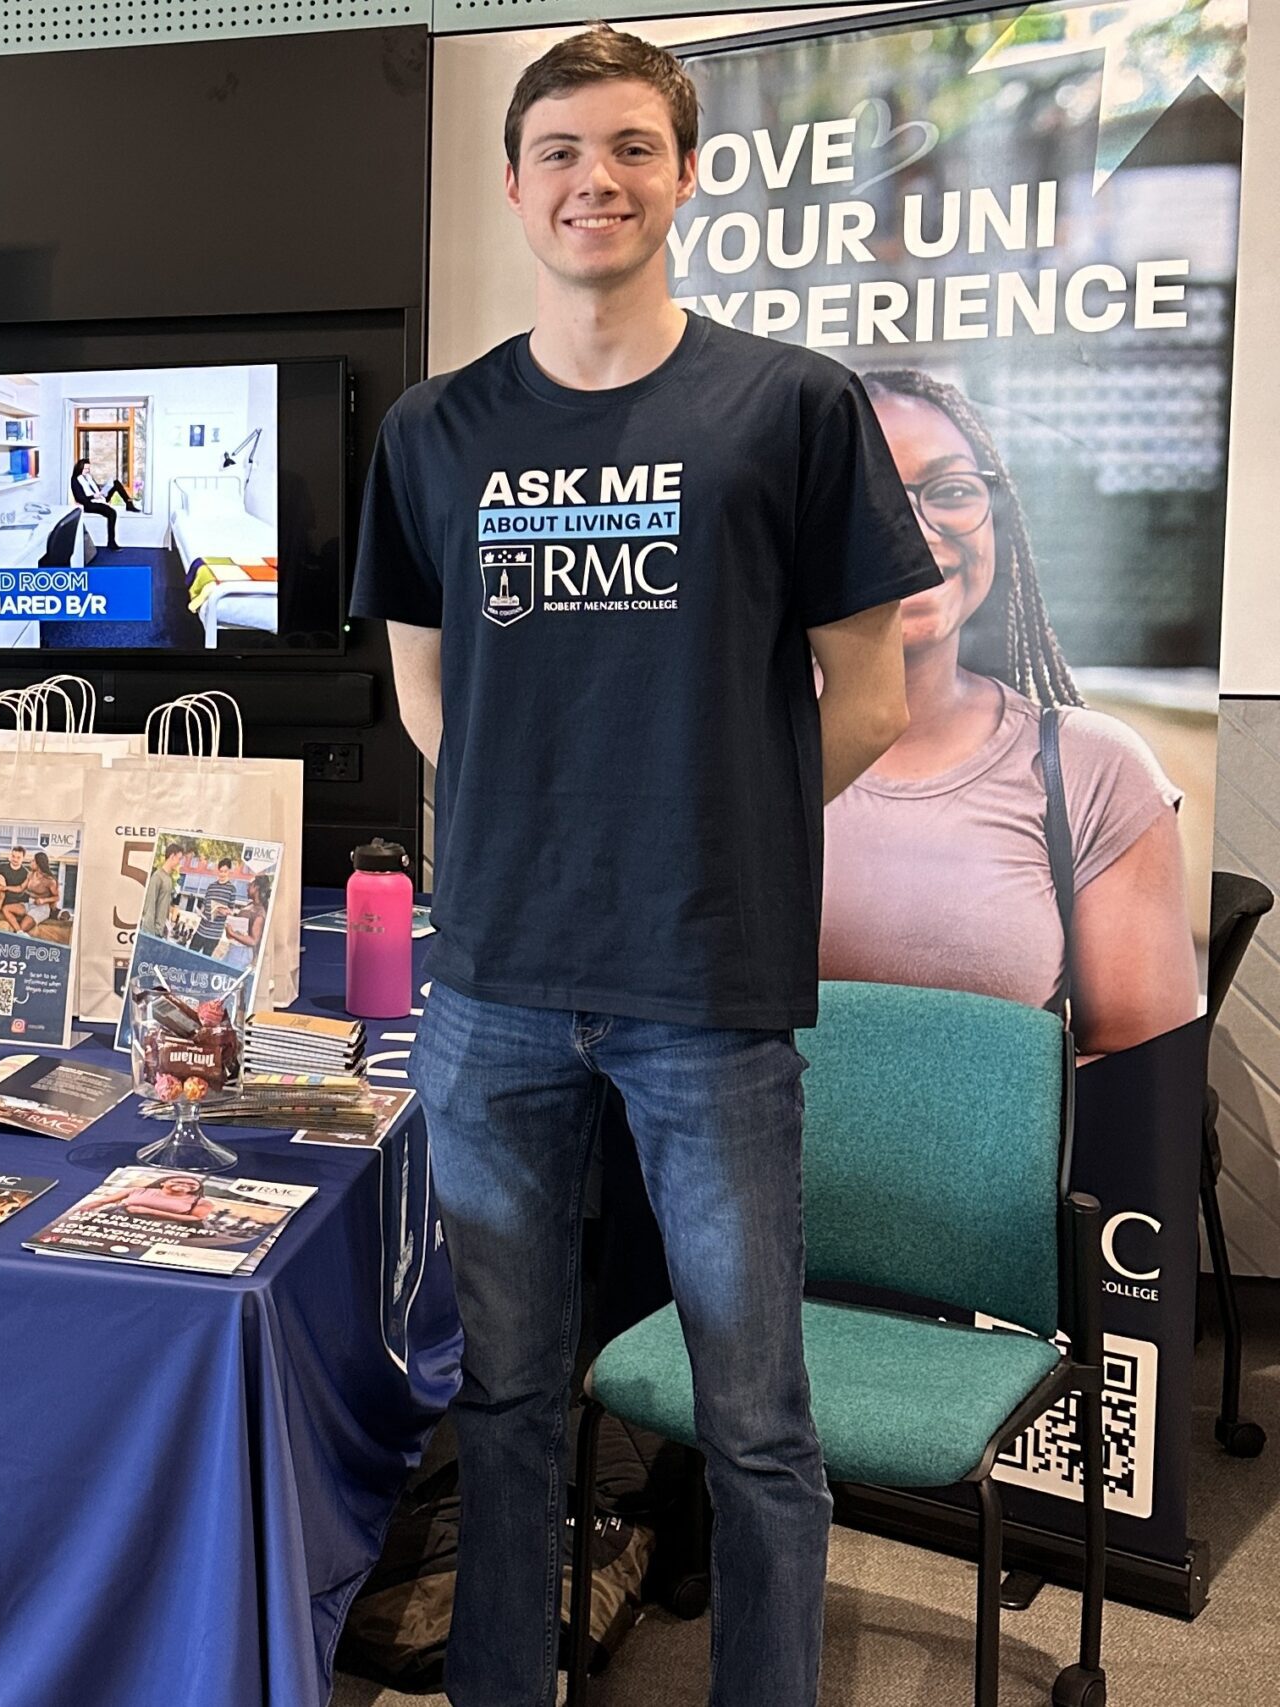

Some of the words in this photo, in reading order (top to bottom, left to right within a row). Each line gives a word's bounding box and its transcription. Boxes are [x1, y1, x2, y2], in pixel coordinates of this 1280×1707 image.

[692, 118, 856, 197] OVE
[666, 201, 876, 278] YOUR
[903, 180, 1057, 258] UNI
[671, 259, 1189, 347] XPERIENCE
[479, 468, 588, 508] ASK
[599, 462, 683, 504] ME
[482, 515, 559, 535] ABOUT
[564, 512, 641, 532] LIVING
[647, 511, 676, 529] AT
[543, 541, 678, 597] RMC
[19, 571, 88, 592] ROOM
[66, 593, 107, 617] B/R
[543, 601, 582, 611] ROBERT
[583, 600, 630, 611] MENZIES
[631, 599, 678, 610] COLLEGE
[51, 833, 74, 846] RMC
[253, 847, 277, 861] RMC
[25, 945, 61, 962] FOR
[190, 971, 209, 989] US
[27, 1115, 78, 1133] RMC
[58, 1223, 100, 1231] LOVE
[103, 1227, 147, 1240] YOUR
[149, 1236, 181, 1245] UNI
[110, 1214, 129, 1222] IN
[132, 1218, 163, 1228] THE
[164, 1223, 218, 1236] HEART
